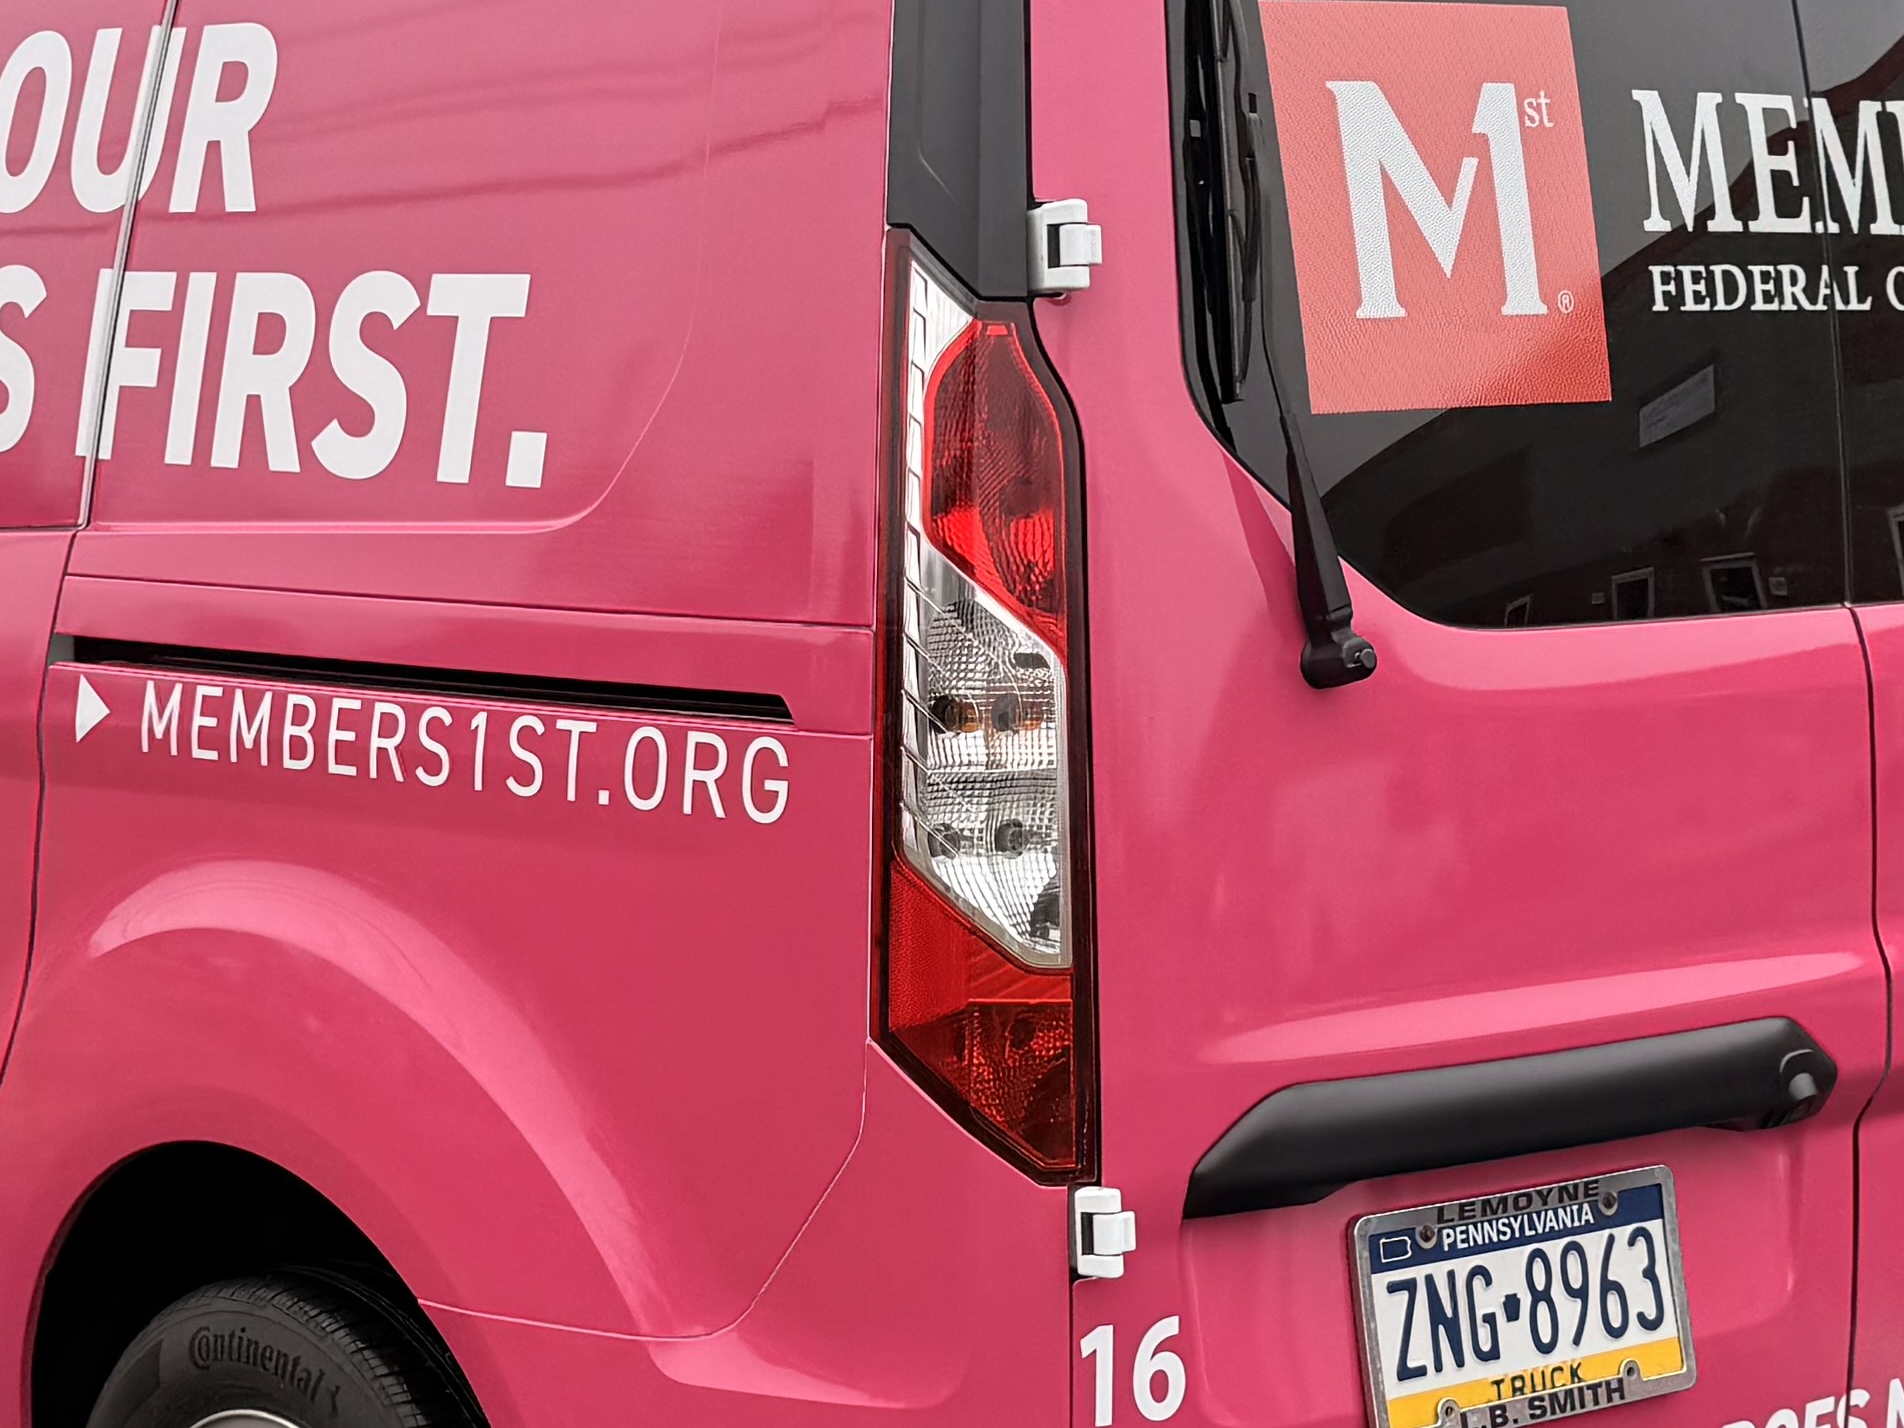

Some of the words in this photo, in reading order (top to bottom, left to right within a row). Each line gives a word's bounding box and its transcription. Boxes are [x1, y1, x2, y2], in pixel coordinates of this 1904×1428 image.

[1648, 263, 1872, 312] FEDERAL
[75, 269, 548, 489] FIRST.
[141, 679, 789, 825] MEMBERS1ST.ORG
[1436, 1179, 1599, 1224] LEMOYNE
[1442, 1203, 1595, 1252] PENNSYLVANIA
[189, 1327, 326, 1403] Continental
[1081, 1315, 1186, 1428] 16
[1491, 1361, 1586, 1400] TRUCK
[1528, 1377, 1626, 1420] SMITH
